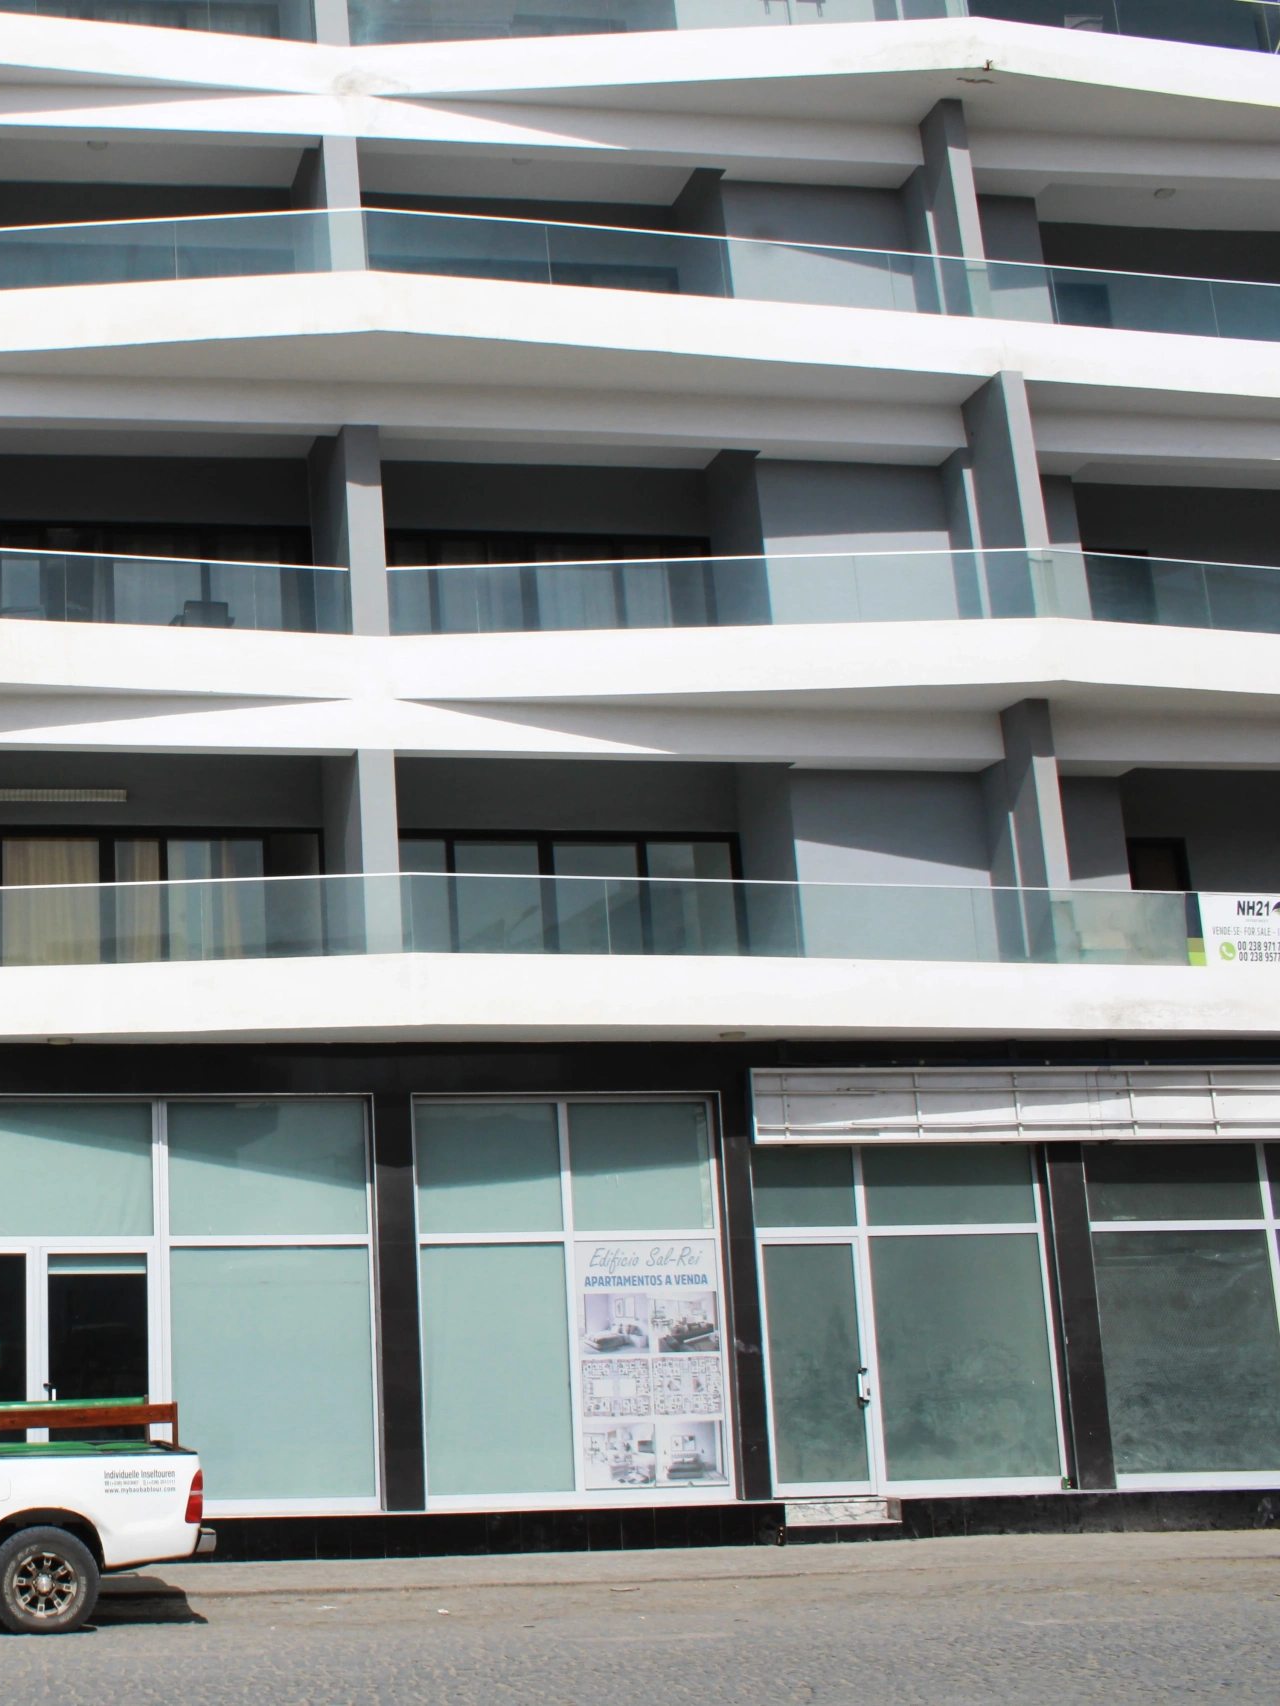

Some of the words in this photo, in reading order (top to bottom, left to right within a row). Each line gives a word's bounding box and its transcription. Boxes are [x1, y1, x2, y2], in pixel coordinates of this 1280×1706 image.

[1236, 900, 1270, 916] NH21
[1244, 927, 1255, 936] FOR
[1257, 928, 1271, 936] SALE
[1237, 941, 1247, 951] 00
[1248, 941, 1261, 951] 238
[1238, 951, 1248, 961] 00
[1250, 952, 1263, 962] 238
[646, 1246, 703, 1267] Sal-Rei
[584, 1274, 663, 1287] APARTAMENTOS
[665, 1275, 673, 1285] A
[674, 1273, 708, 1285] VENDA
[104, 1470, 139, 1480] Individuelle
[141, 1469, 176, 1479] Inseltouren
